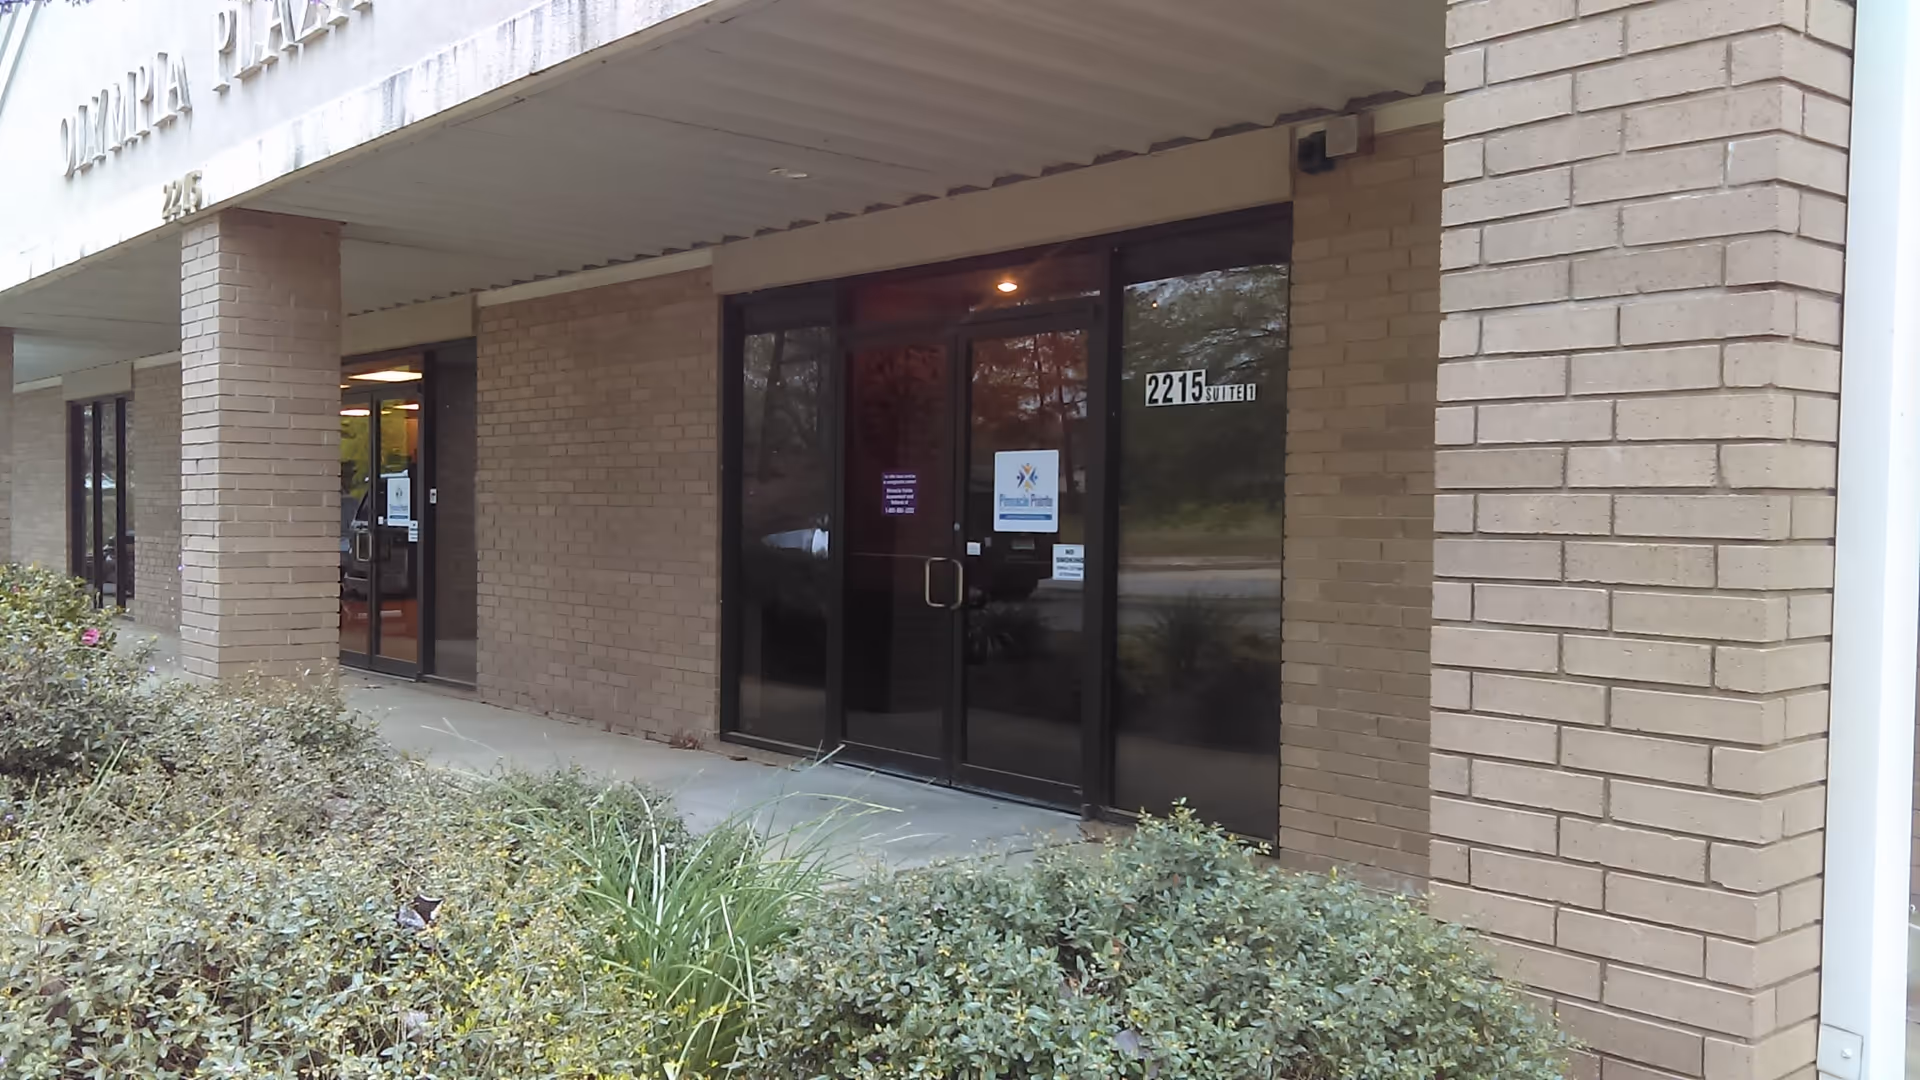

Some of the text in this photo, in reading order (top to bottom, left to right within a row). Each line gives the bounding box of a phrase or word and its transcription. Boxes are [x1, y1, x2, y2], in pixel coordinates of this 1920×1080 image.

[59, 0, 374, 177] OLYMPIA PLA
[1147, 371, 1203, 405] 2215
[1205, 386, 1243, 401] SUITE
